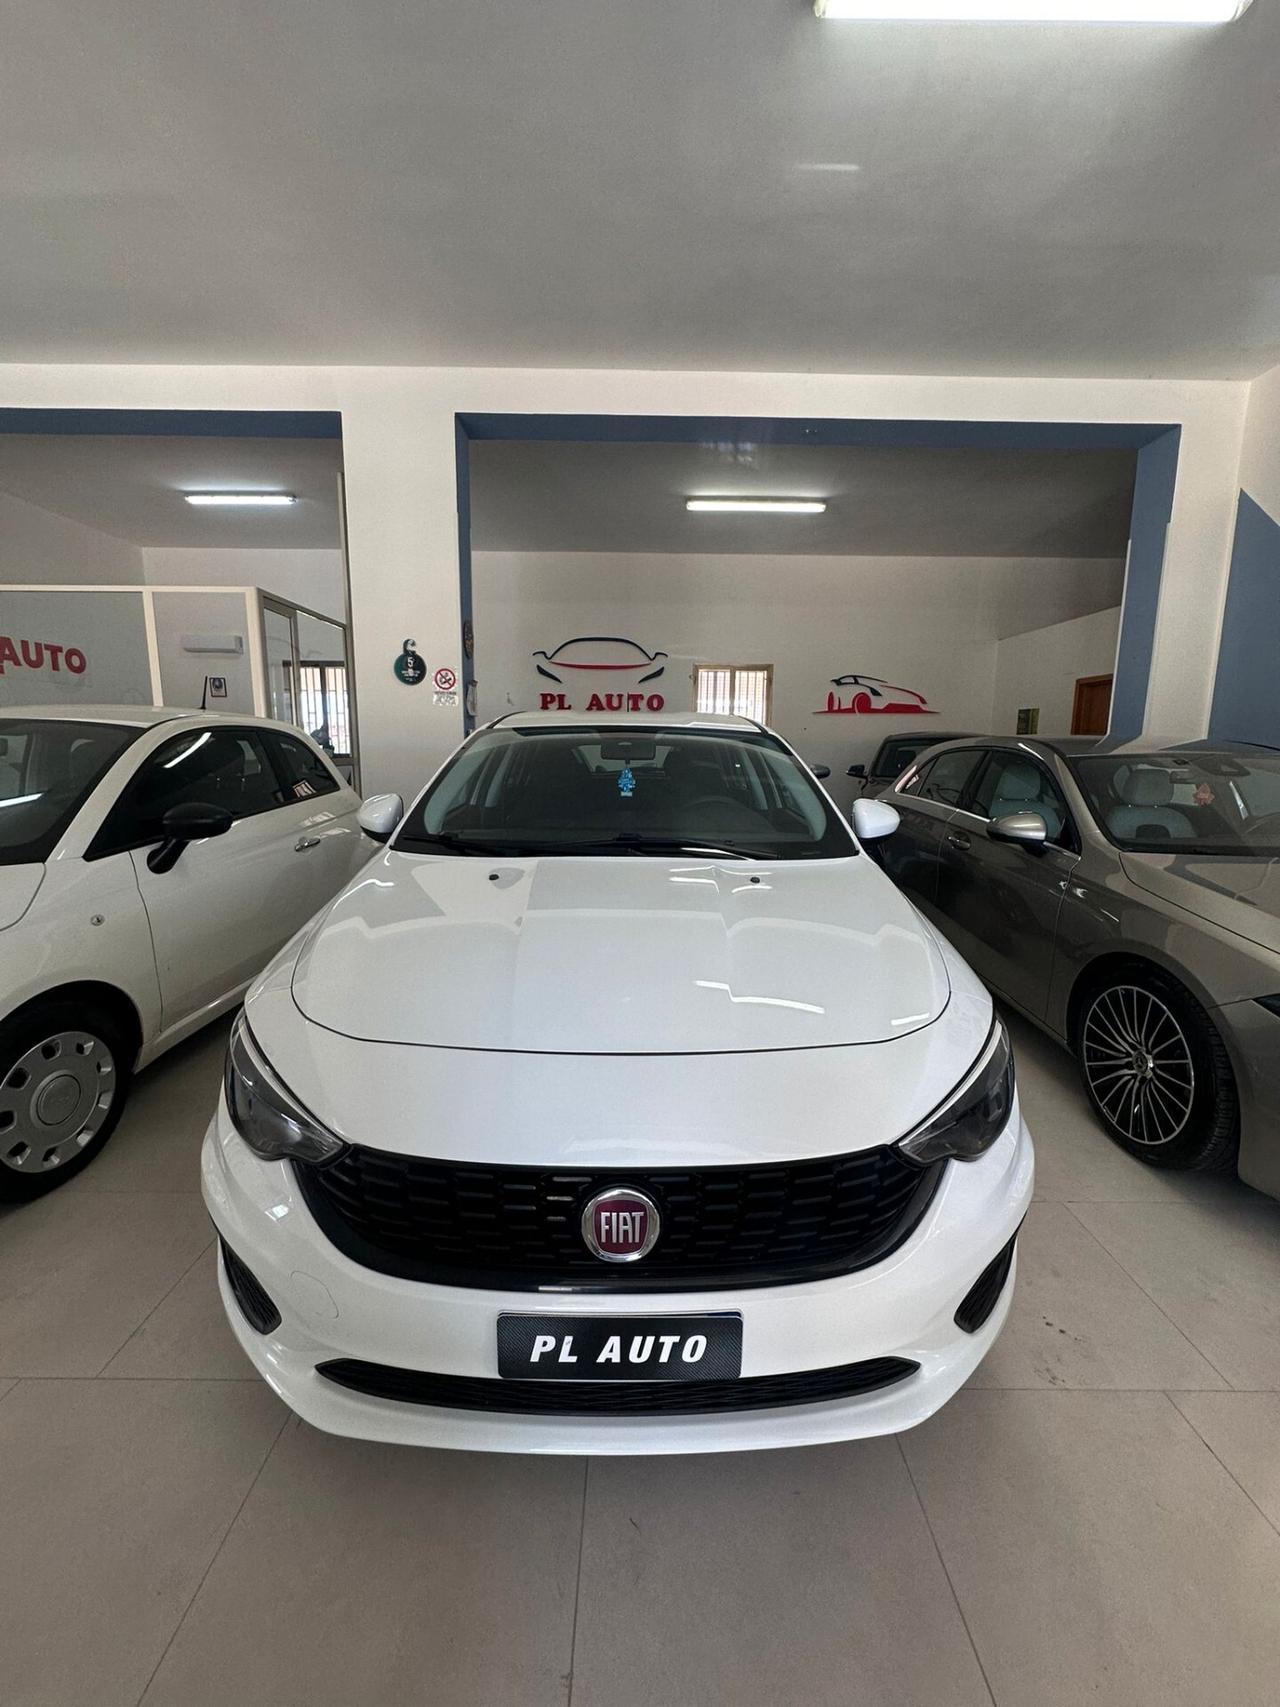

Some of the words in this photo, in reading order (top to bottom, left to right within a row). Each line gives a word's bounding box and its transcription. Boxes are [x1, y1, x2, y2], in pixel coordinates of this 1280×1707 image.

[0, 636, 86, 674] AUTO
[540, 693, 572, 710] PL
[586, 693, 664, 711] AUTO
[600, 1211, 645, 1244] FIAT
[530, 1335, 578, 1363] PL
[596, 1335, 708, 1364] AUTO
